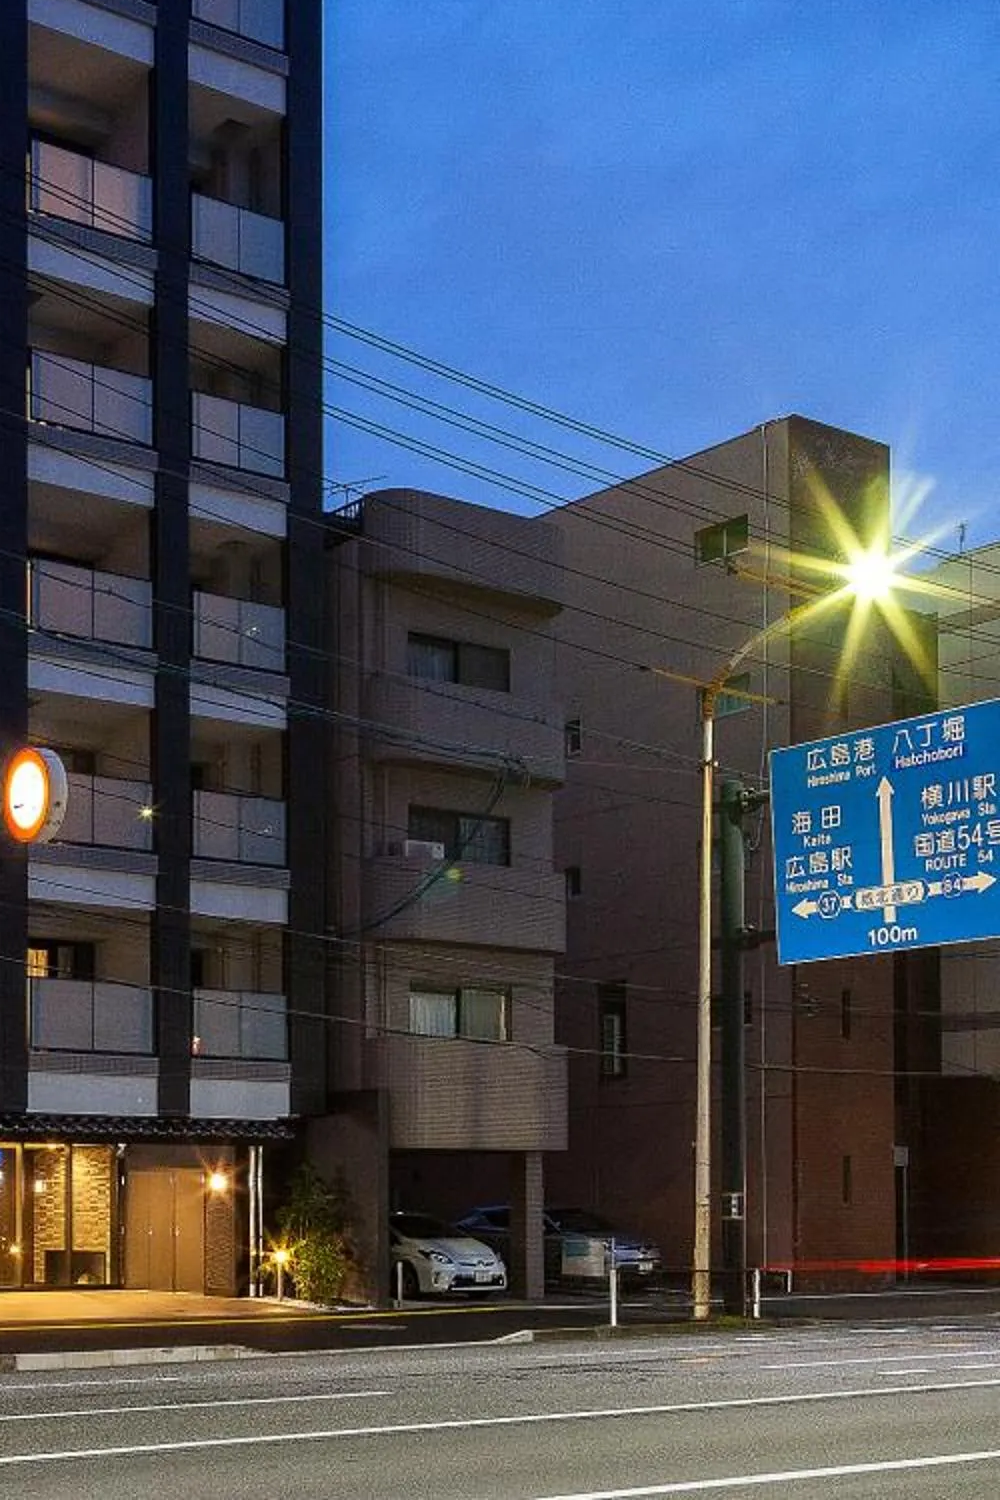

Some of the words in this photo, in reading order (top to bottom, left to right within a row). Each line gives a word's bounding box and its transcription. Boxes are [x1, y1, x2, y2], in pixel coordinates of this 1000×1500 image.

[893, 715, 965, 753] 八丁堀
[807, 737, 875, 771] 広島港
[895, 743, 963, 769] Hatchobori
[807, 770, 850, 788] Hiroshima
[855, 763, 876, 777] Port
[921, 773, 997, 810] 横川駅
[792, 805, 841, 834] 海田
[922, 808, 970, 827] Yokogawa
[803, 833, 831, 848] Kaita
[915, 819, 1000, 857] 国道54号
[786, 846, 853, 878] 広島駅
[925, 853, 967, 872] ROUTE
[977, 849, 993, 863] 54
[786, 879, 829, 894] Hiroshima
[822, 896, 837, 913] 37
[868, 925, 917, 946] 100m
